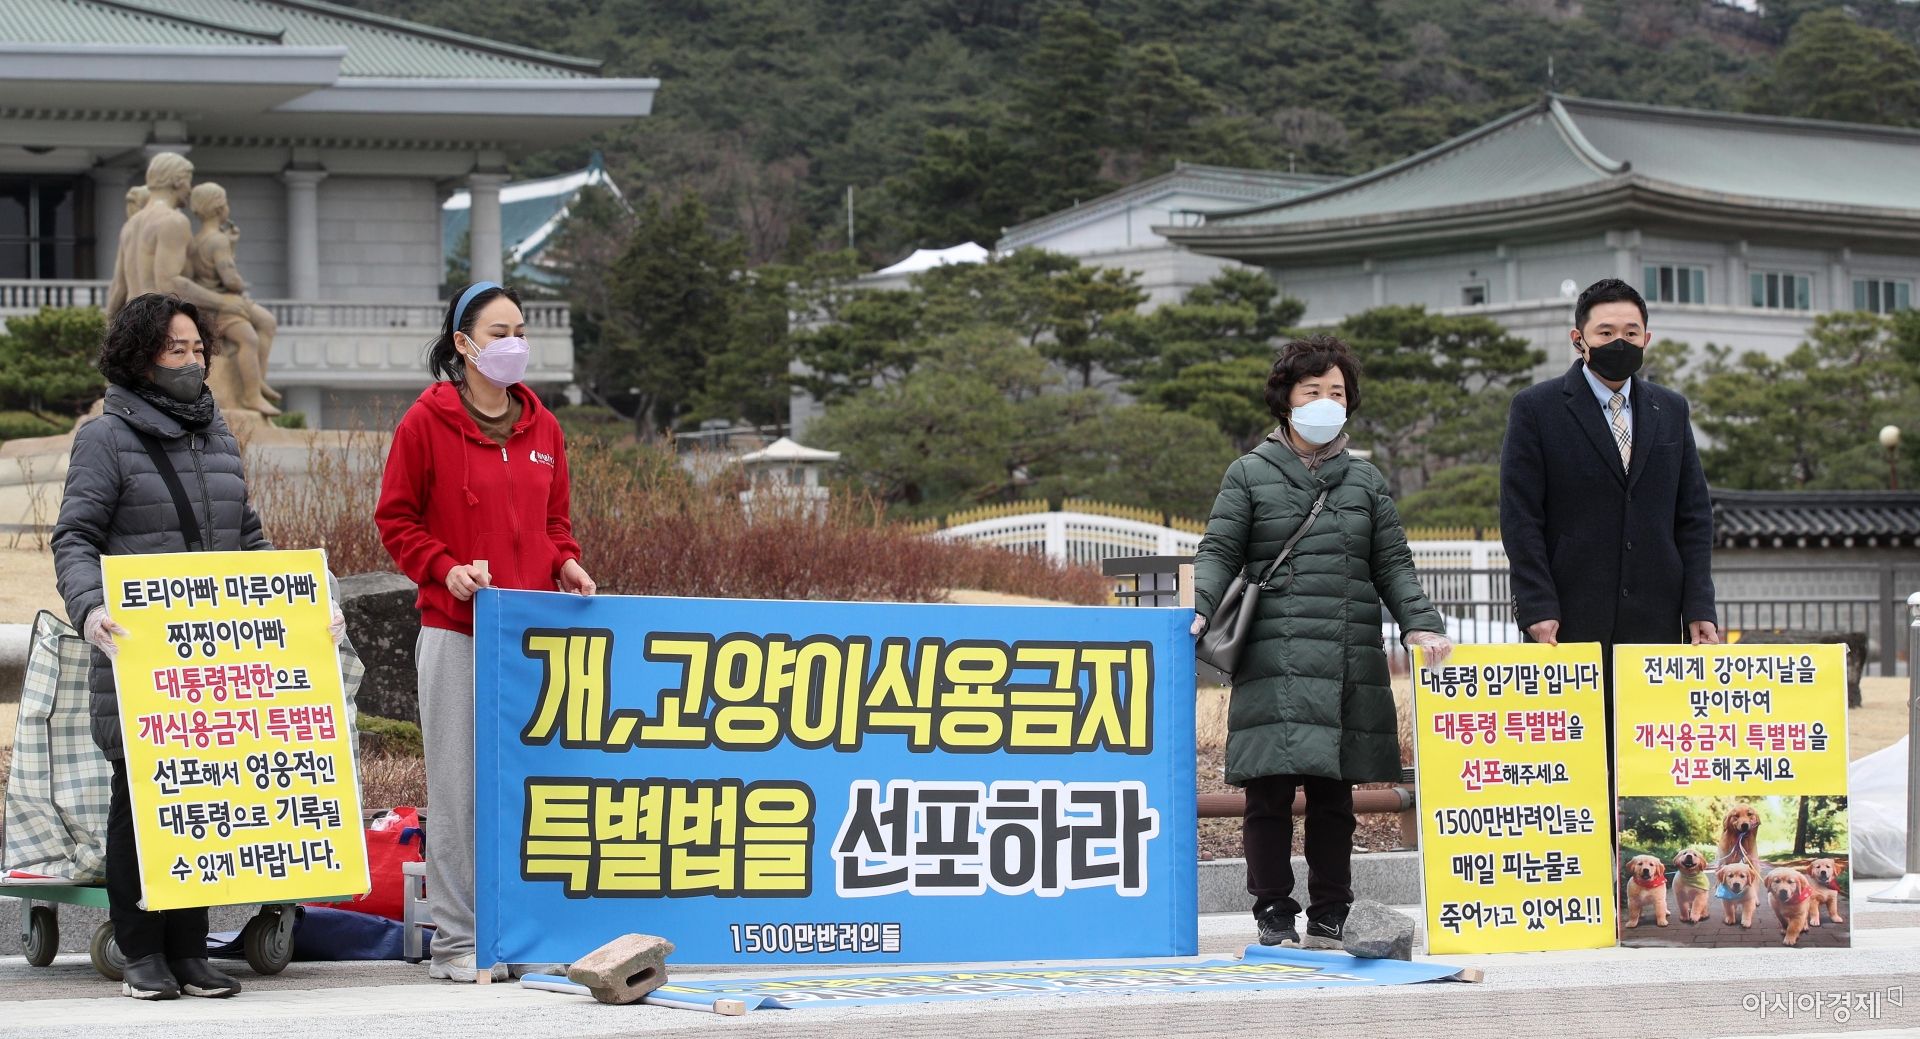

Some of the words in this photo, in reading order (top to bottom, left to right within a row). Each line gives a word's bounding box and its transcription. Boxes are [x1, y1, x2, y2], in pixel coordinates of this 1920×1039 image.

[121, 577, 219, 609] 토리아빠
[225, 573, 317, 606] 마루아빠
[167, 619, 286, 659] 찡찡이아빠
[154, 663, 311, 703] 대통령권한으로
[1420, 666, 1478, 698] 대통령
[1483, 664, 1540, 696] 임기말
[1543, 663, 1599, 695] 입니다
[1644, 657, 1704, 684] 전세계
[1714, 655, 1816, 685] 강아지날을
[522, 628, 1153, 754] 개,고양이식용금지
[1690, 690, 1770, 718] 맞이하여
[138, 709, 260, 748] 개식용금지
[266, 705, 336, 742] 특별법
[1434, 712, 1497, 745] 대통령
[1504, 710, 1584, 743] 특별법을
[1635, 723, 1736, 752] 개식용금지
[1746, 722, 1828, 751] 특별법을
[153, 759, 240, 795] 선포해서
[246, 750, 335, 790] 영웅적인
[1461, 759, 1569, 791] 선포해주세요
[1671, 757, 1794, 785] 선포해주세요
[158, 801, 270, 840] 대통령으로
[276, 796, 341, 830] 기록될
[1435, 804, 1594, 837] 1500만반려인들은
[522, 776, 816, 898] 특별법을
[833, 780, 1159, 897] 선포하라
[171, 856, 193, 881] 수
[197, 852, 235, 882] 있게
[239, 839, 340, 878] 바랍니다.
[1452, 853, 1494, 885] 매일
[1502, 851, 1582, 883] 피눈물로
[1440, 901, 1517, 934] 죽어가고
[1522, 897, 1601, 930] 있어요!!
[730, 923, 902, 952] 1500만반려인들
